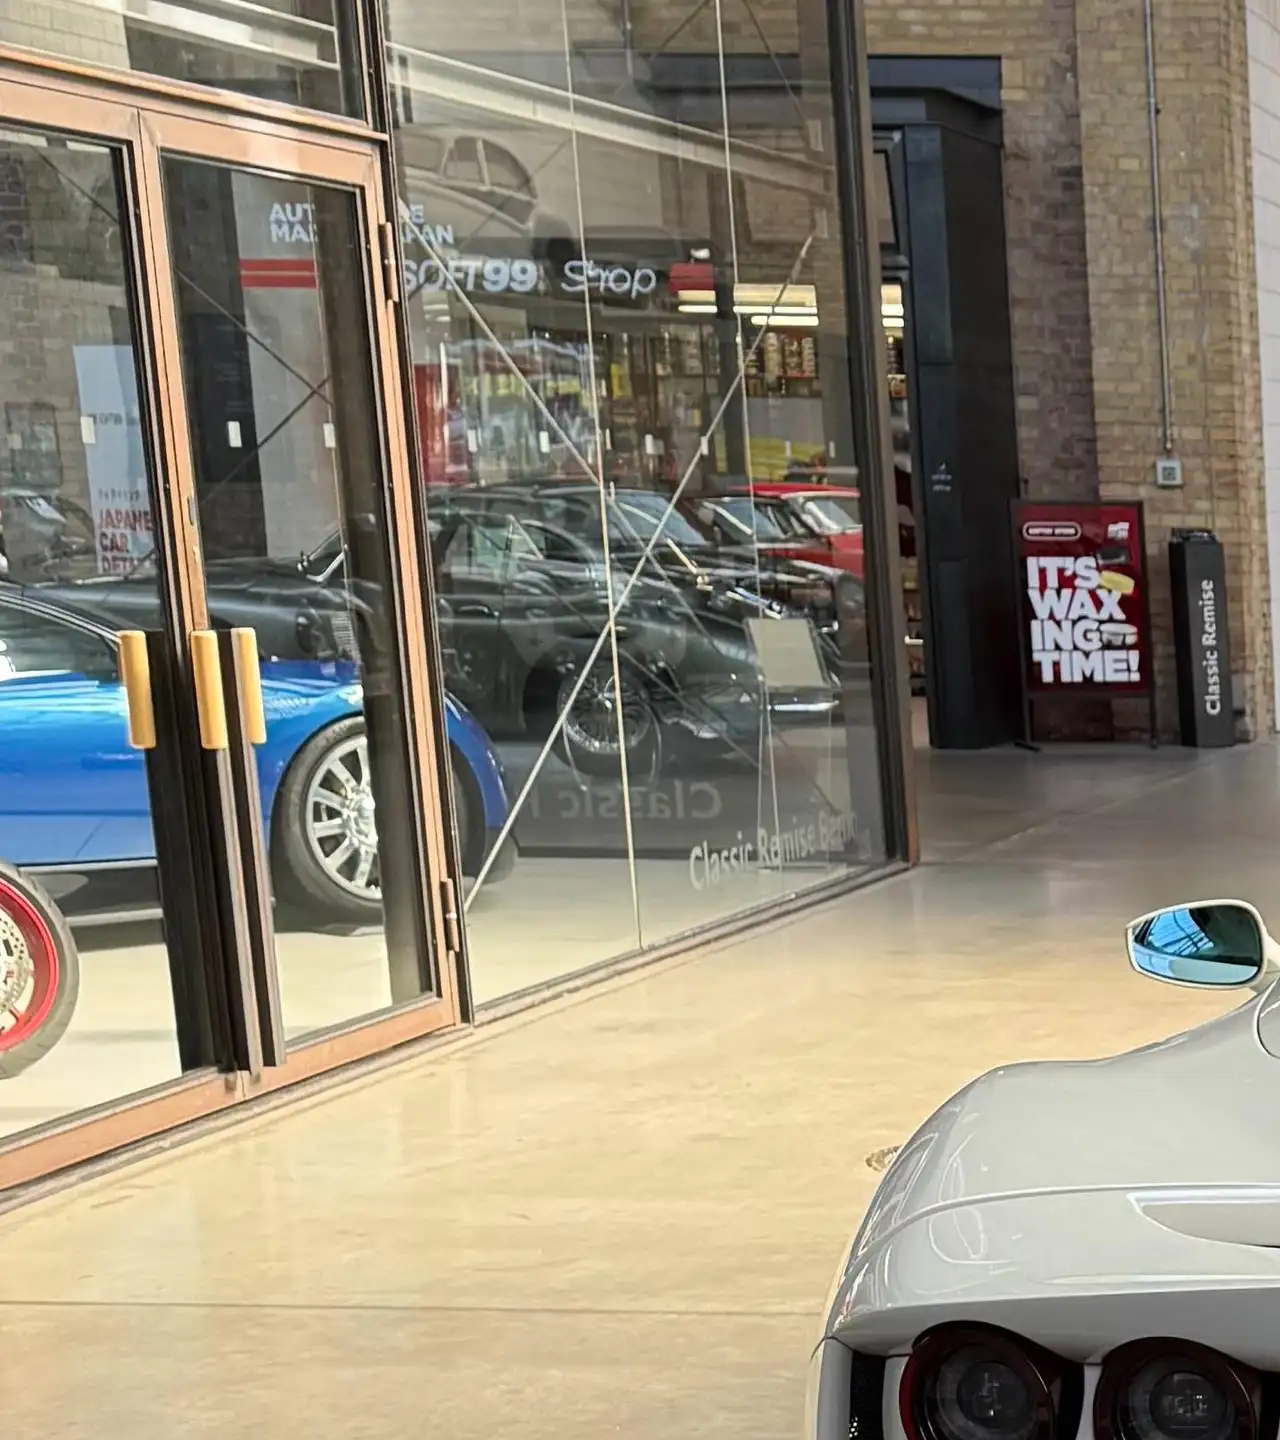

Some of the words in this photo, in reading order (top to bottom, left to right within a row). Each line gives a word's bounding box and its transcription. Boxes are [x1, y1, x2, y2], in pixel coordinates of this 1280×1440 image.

[1026, 556, 1099, 588] IT'S
[1027, 588, 1126, 620] WAX
[1198, 579, 1217, 646] Remise
[1030, 619, 1102, 651] ING
[1033, 650, 1141, 683] TIME!
[1203, 650, 1222, 716] Classic
[689, 830, 753, 892] Classic
